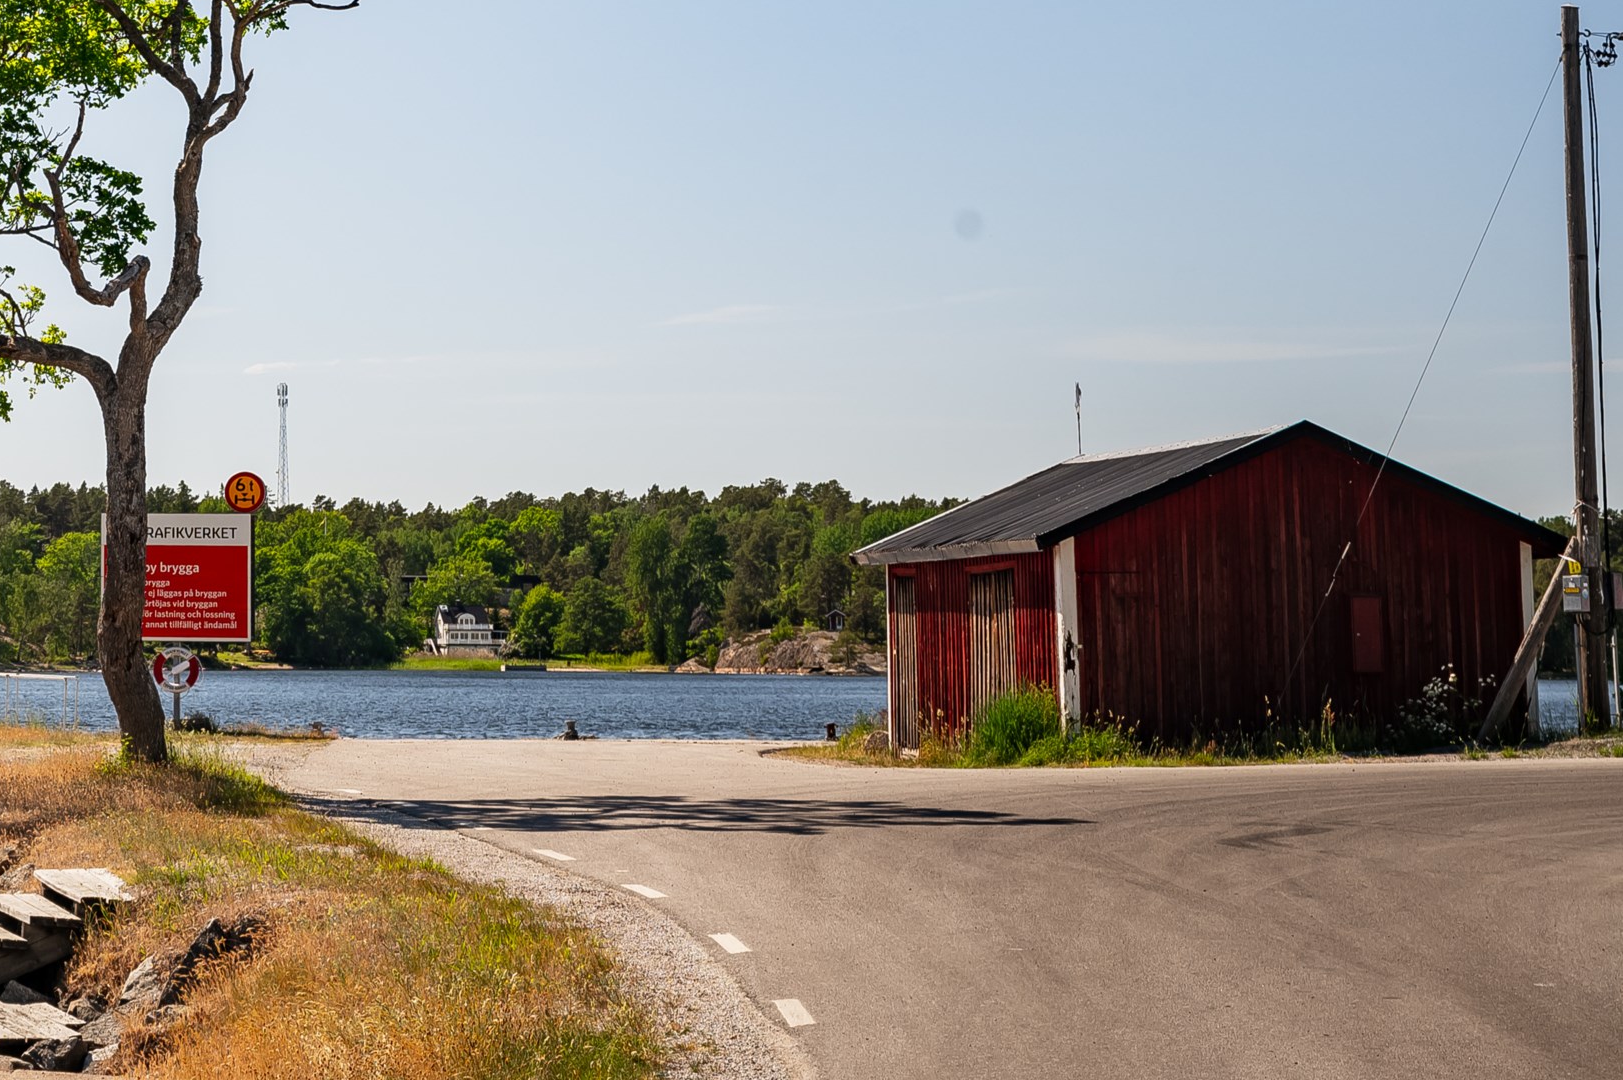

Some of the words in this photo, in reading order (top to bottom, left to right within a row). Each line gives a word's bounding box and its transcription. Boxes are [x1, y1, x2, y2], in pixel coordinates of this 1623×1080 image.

[235, 478, 245, 491] 6
[146, 526, 238, 539] RAFIKVERKET
[160, 561, 200, 576] brygga
[148, 589, 156, 598] ej
[157, 589, 182, 599] läggas
[183, 589, 194, 599] på
[195, 589, 227, 599] bryggan
[186, 600, 218, 609] bryggan
[154, 610, 186, 619] lastning
[187, 610, 201, 618] och
[203, 610, 235, 620] lossning
[145, 621, 168, 629] annat
[169, 621, 202, 630] tillfälligt
[203, 621, 237, 629] ändamål
